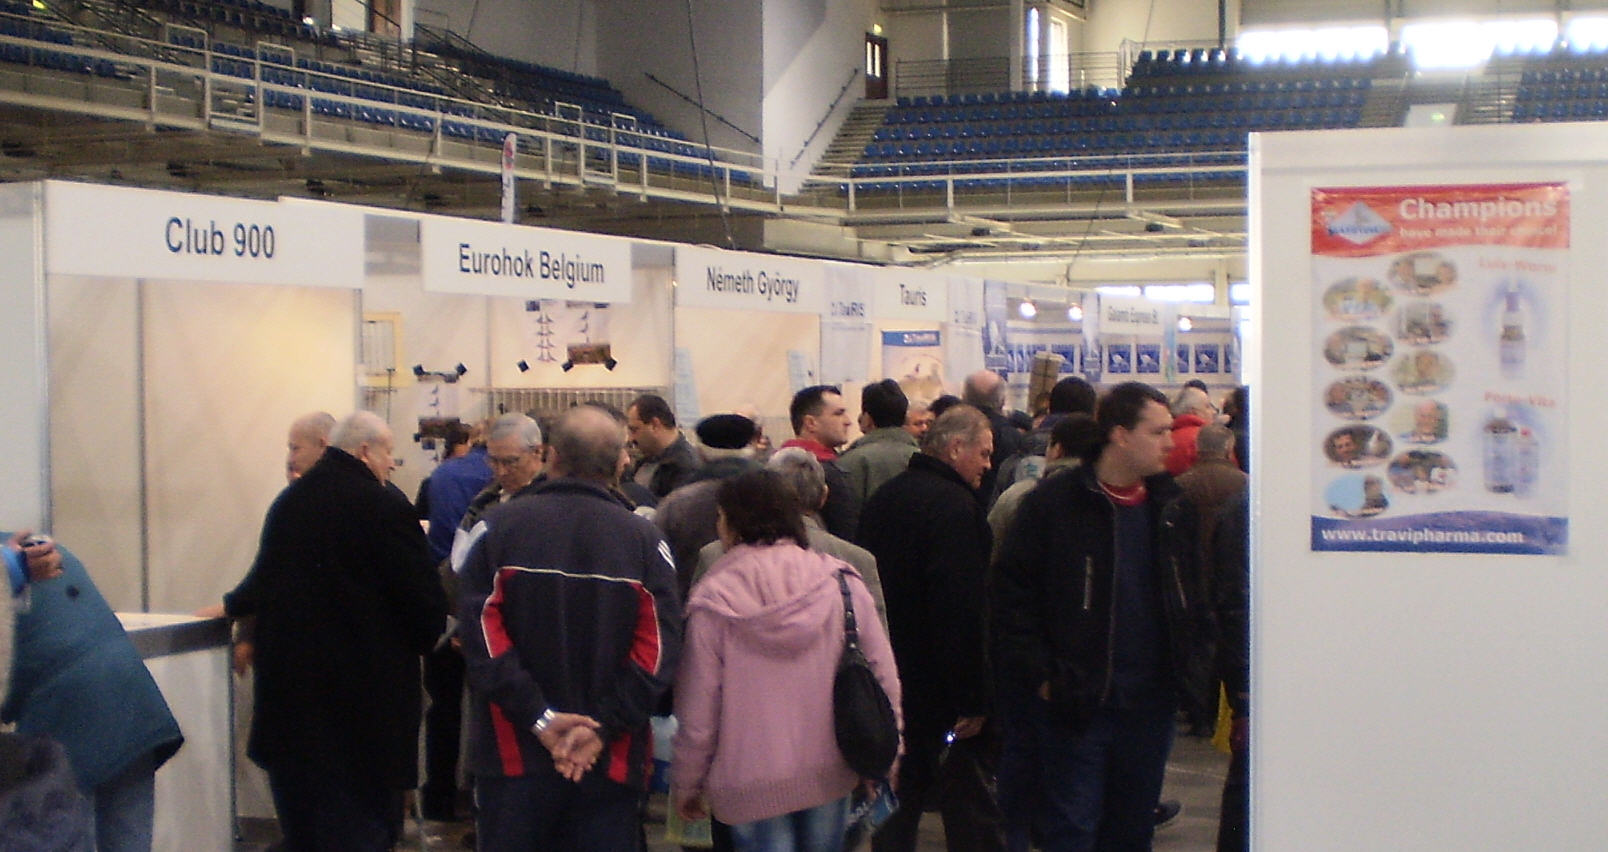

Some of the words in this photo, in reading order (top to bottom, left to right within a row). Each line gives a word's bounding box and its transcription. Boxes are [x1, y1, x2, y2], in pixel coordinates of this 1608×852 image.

[1399, 196, 1558, 221] Champions
[165, 216, 225, 256] Club
[233, 222, 276, 260] 900
[458, 242, 534, 278] Eurohok
[539, 250, 605, 289] Belgium
[706, 266, 754, 294] Németh
[757, 270, 800, 313] György
[899, 282, 927, 307] Tauris
[1320, 527, 1525, 546] www.travipharma.com
